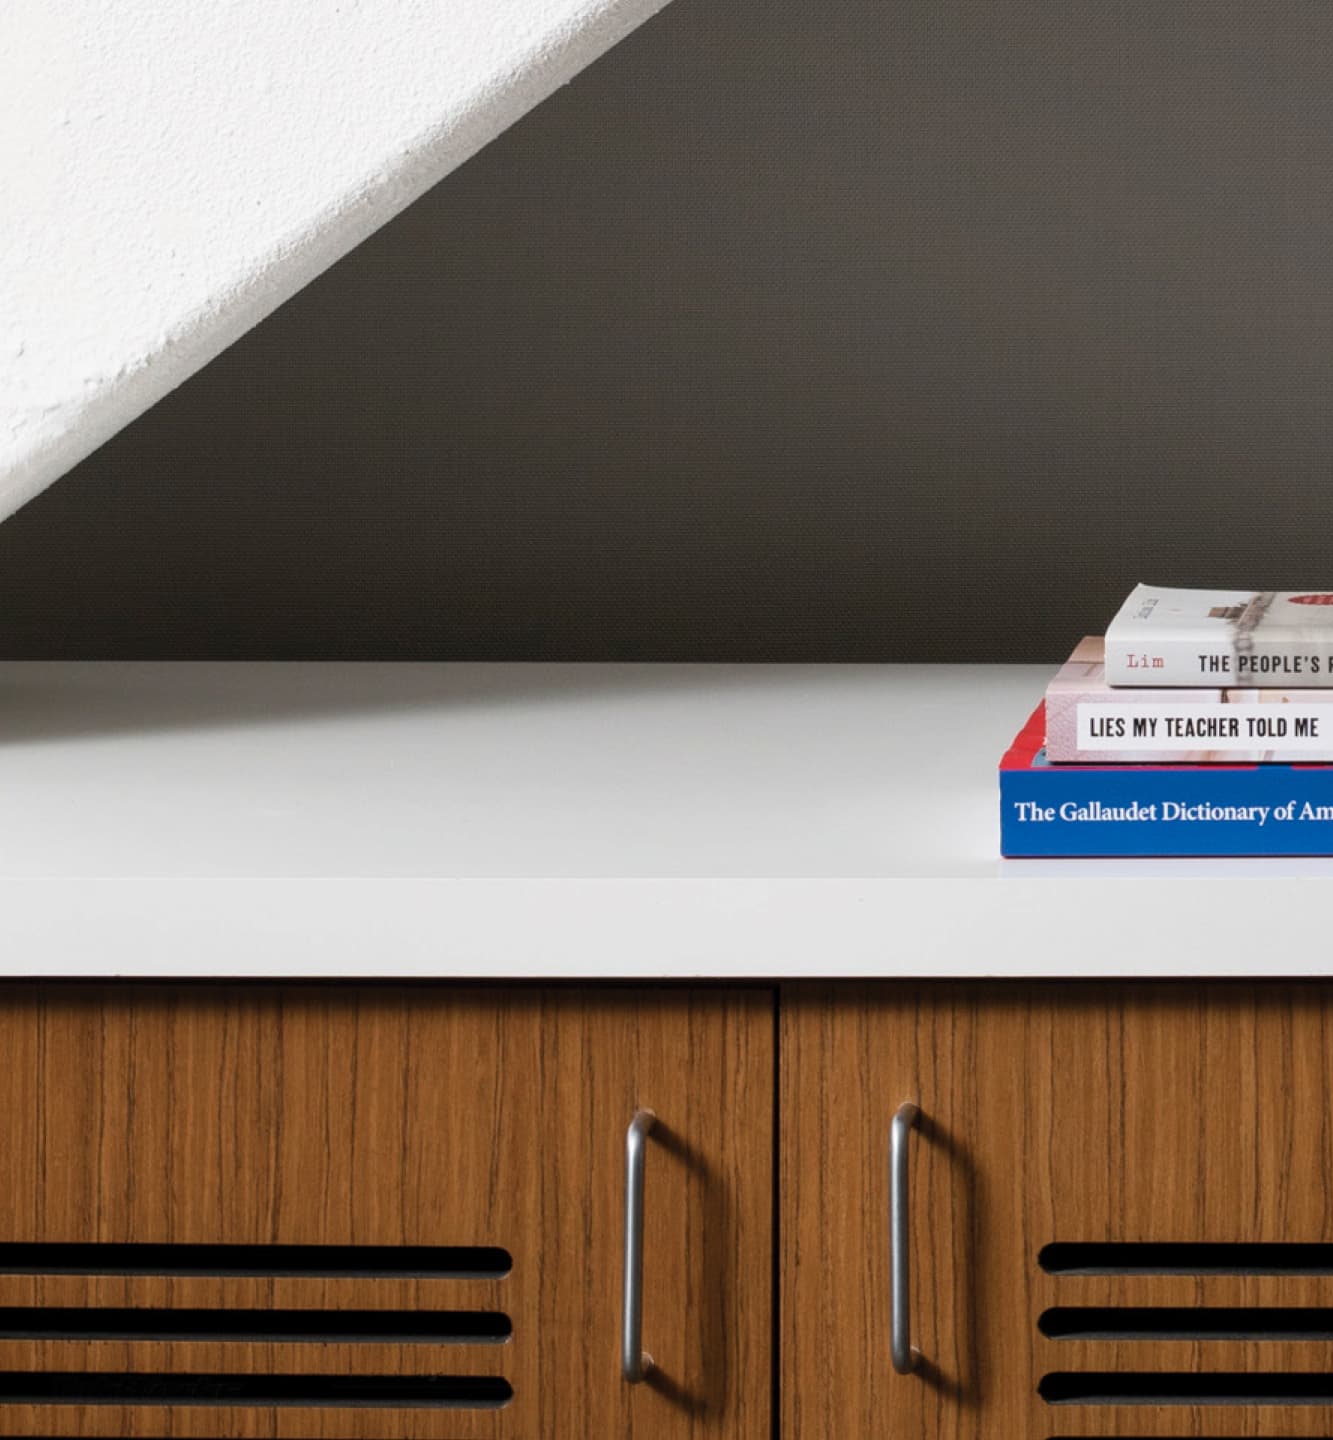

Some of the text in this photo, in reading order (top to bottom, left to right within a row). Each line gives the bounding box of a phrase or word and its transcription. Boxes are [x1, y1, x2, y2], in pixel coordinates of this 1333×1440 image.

[1127, 654, 1164, 668] Lim
[1198, 655, 1230, 672] THE
[1238, 655, 1320, 673] PEOPLE'S
[1090, 717, 1319, 737] LIES MY TEACHER TOLD ME
[1014, 801, 1055, 822] The
[1060, 800, 1157, 822] Gallaudet
[1162, 801, 1270, 826] Dictionary
[1273, 800, 1297, 821] of
